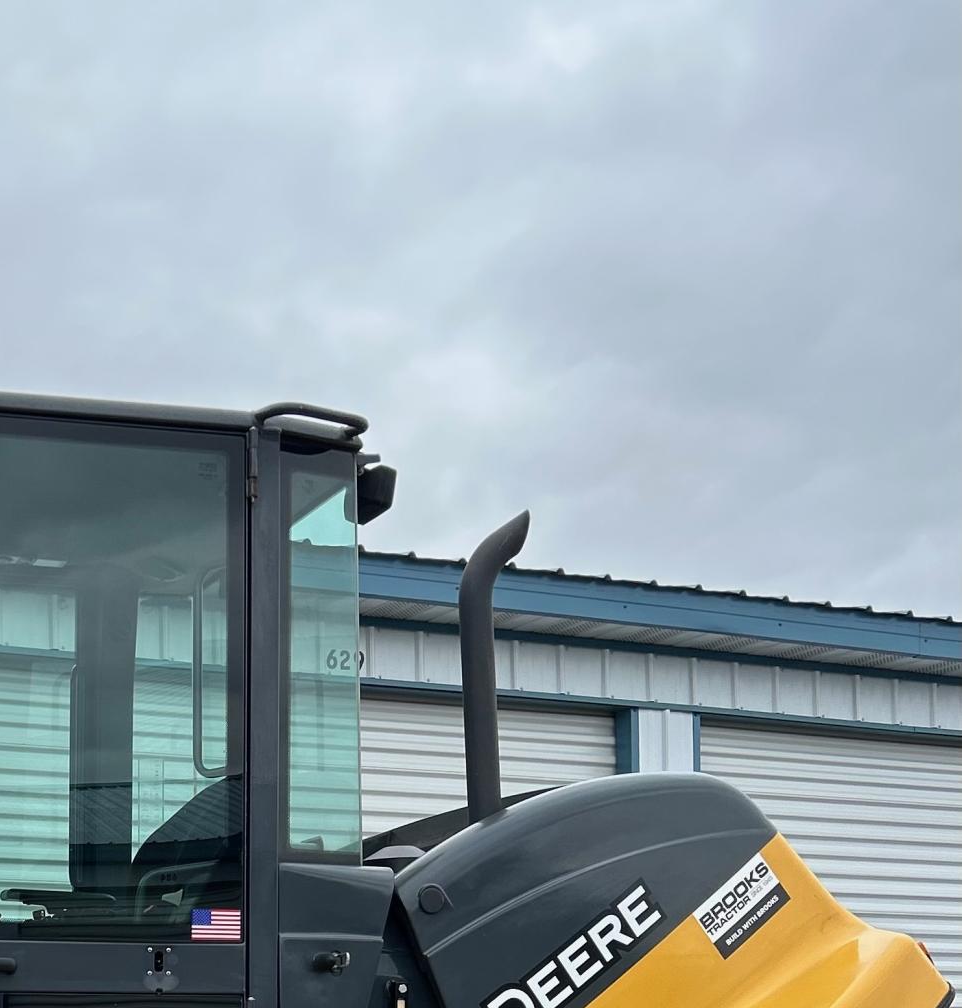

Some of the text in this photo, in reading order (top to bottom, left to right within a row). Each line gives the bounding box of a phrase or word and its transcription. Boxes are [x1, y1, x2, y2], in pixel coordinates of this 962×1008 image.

[326, 648, 365, 671] 629
[698, 861, 769, 930] BROOKS
[706, 895, 752, 936] TRACTOR
[725, 894, 779, 946] BUILD WITH BROOKS
